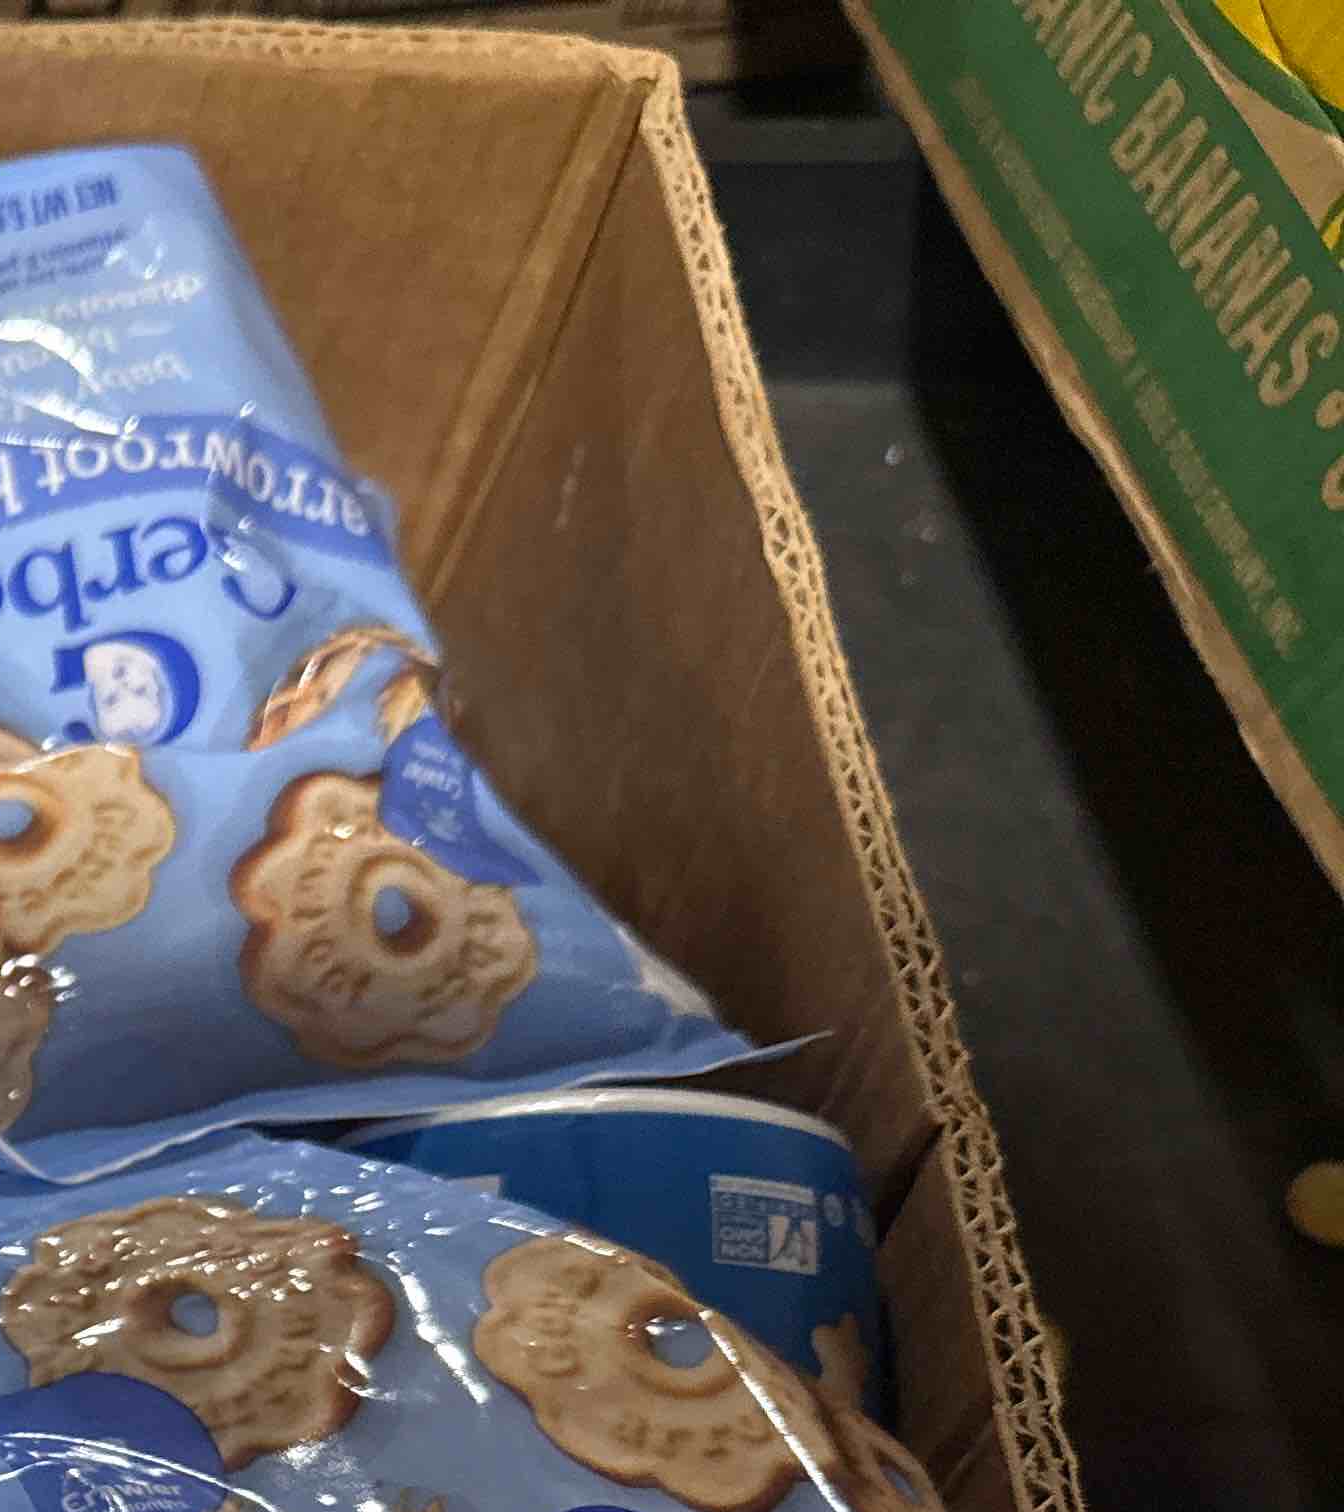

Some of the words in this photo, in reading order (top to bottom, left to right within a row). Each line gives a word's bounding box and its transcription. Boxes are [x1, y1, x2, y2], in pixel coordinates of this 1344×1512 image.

[28, 185, 69, 225] WT
[73, 175, 118, 212] NET
[1112, 76, 1339, 407] BANANAS
[36, 420, 371, 539] arrowroot
